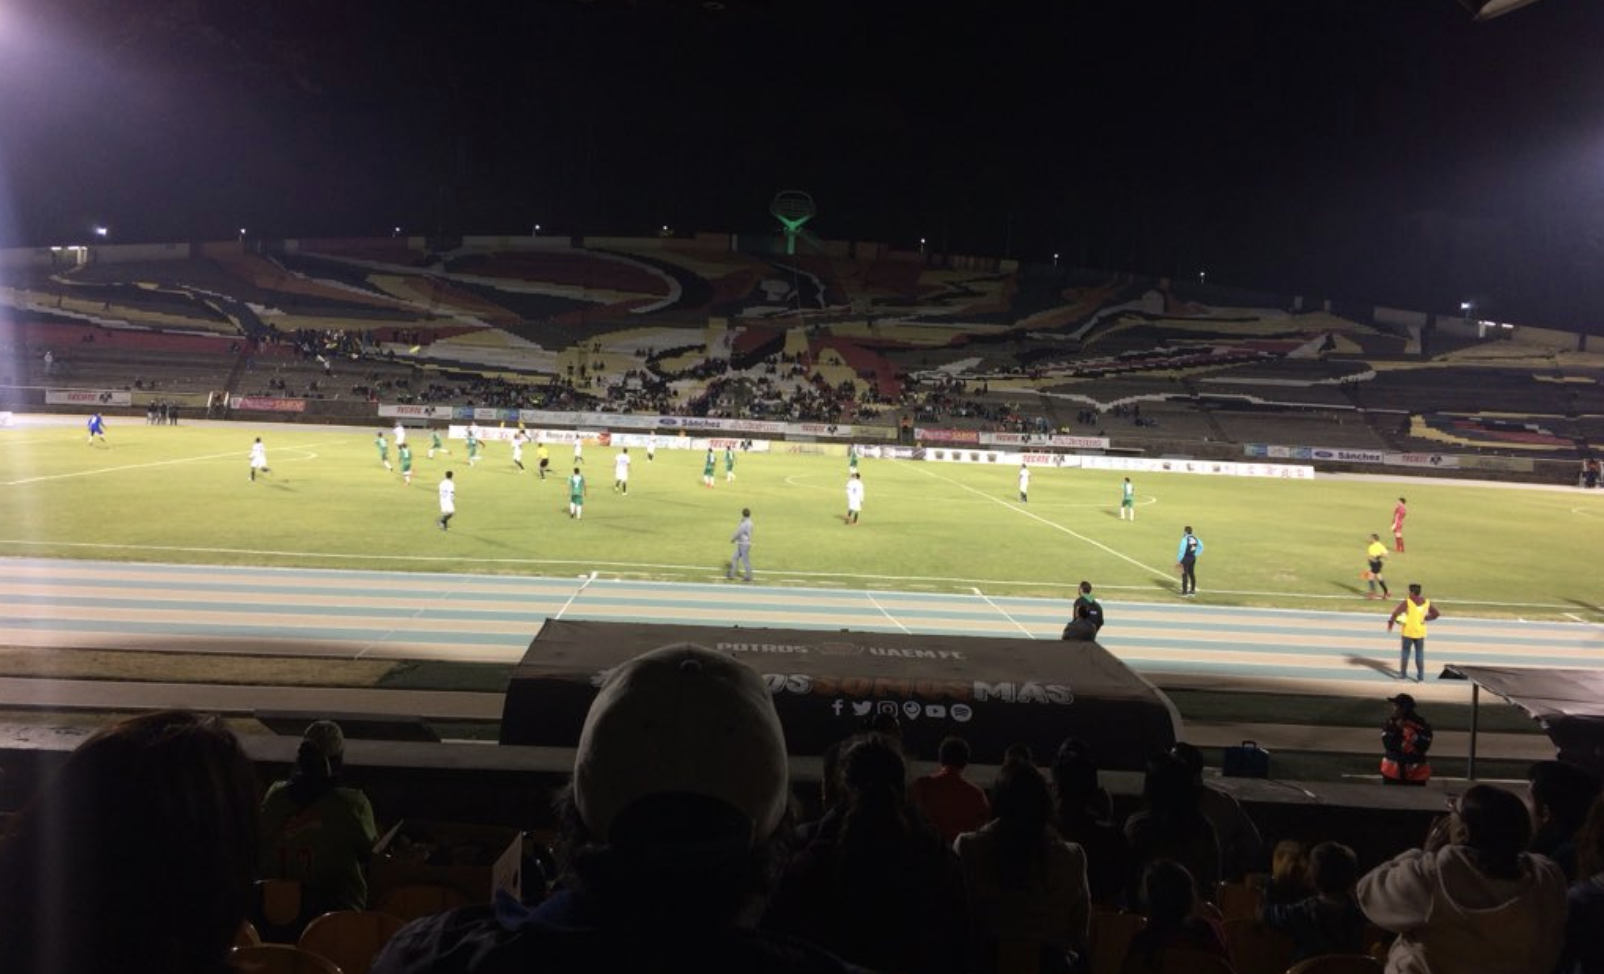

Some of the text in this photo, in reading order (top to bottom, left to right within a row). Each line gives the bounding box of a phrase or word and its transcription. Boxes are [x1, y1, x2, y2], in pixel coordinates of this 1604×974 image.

[1022, 454, 1051, 464] TECATE
[1338, 450, 1381, 462] Sánchez
[716, 642, 809, 655] POTROS
